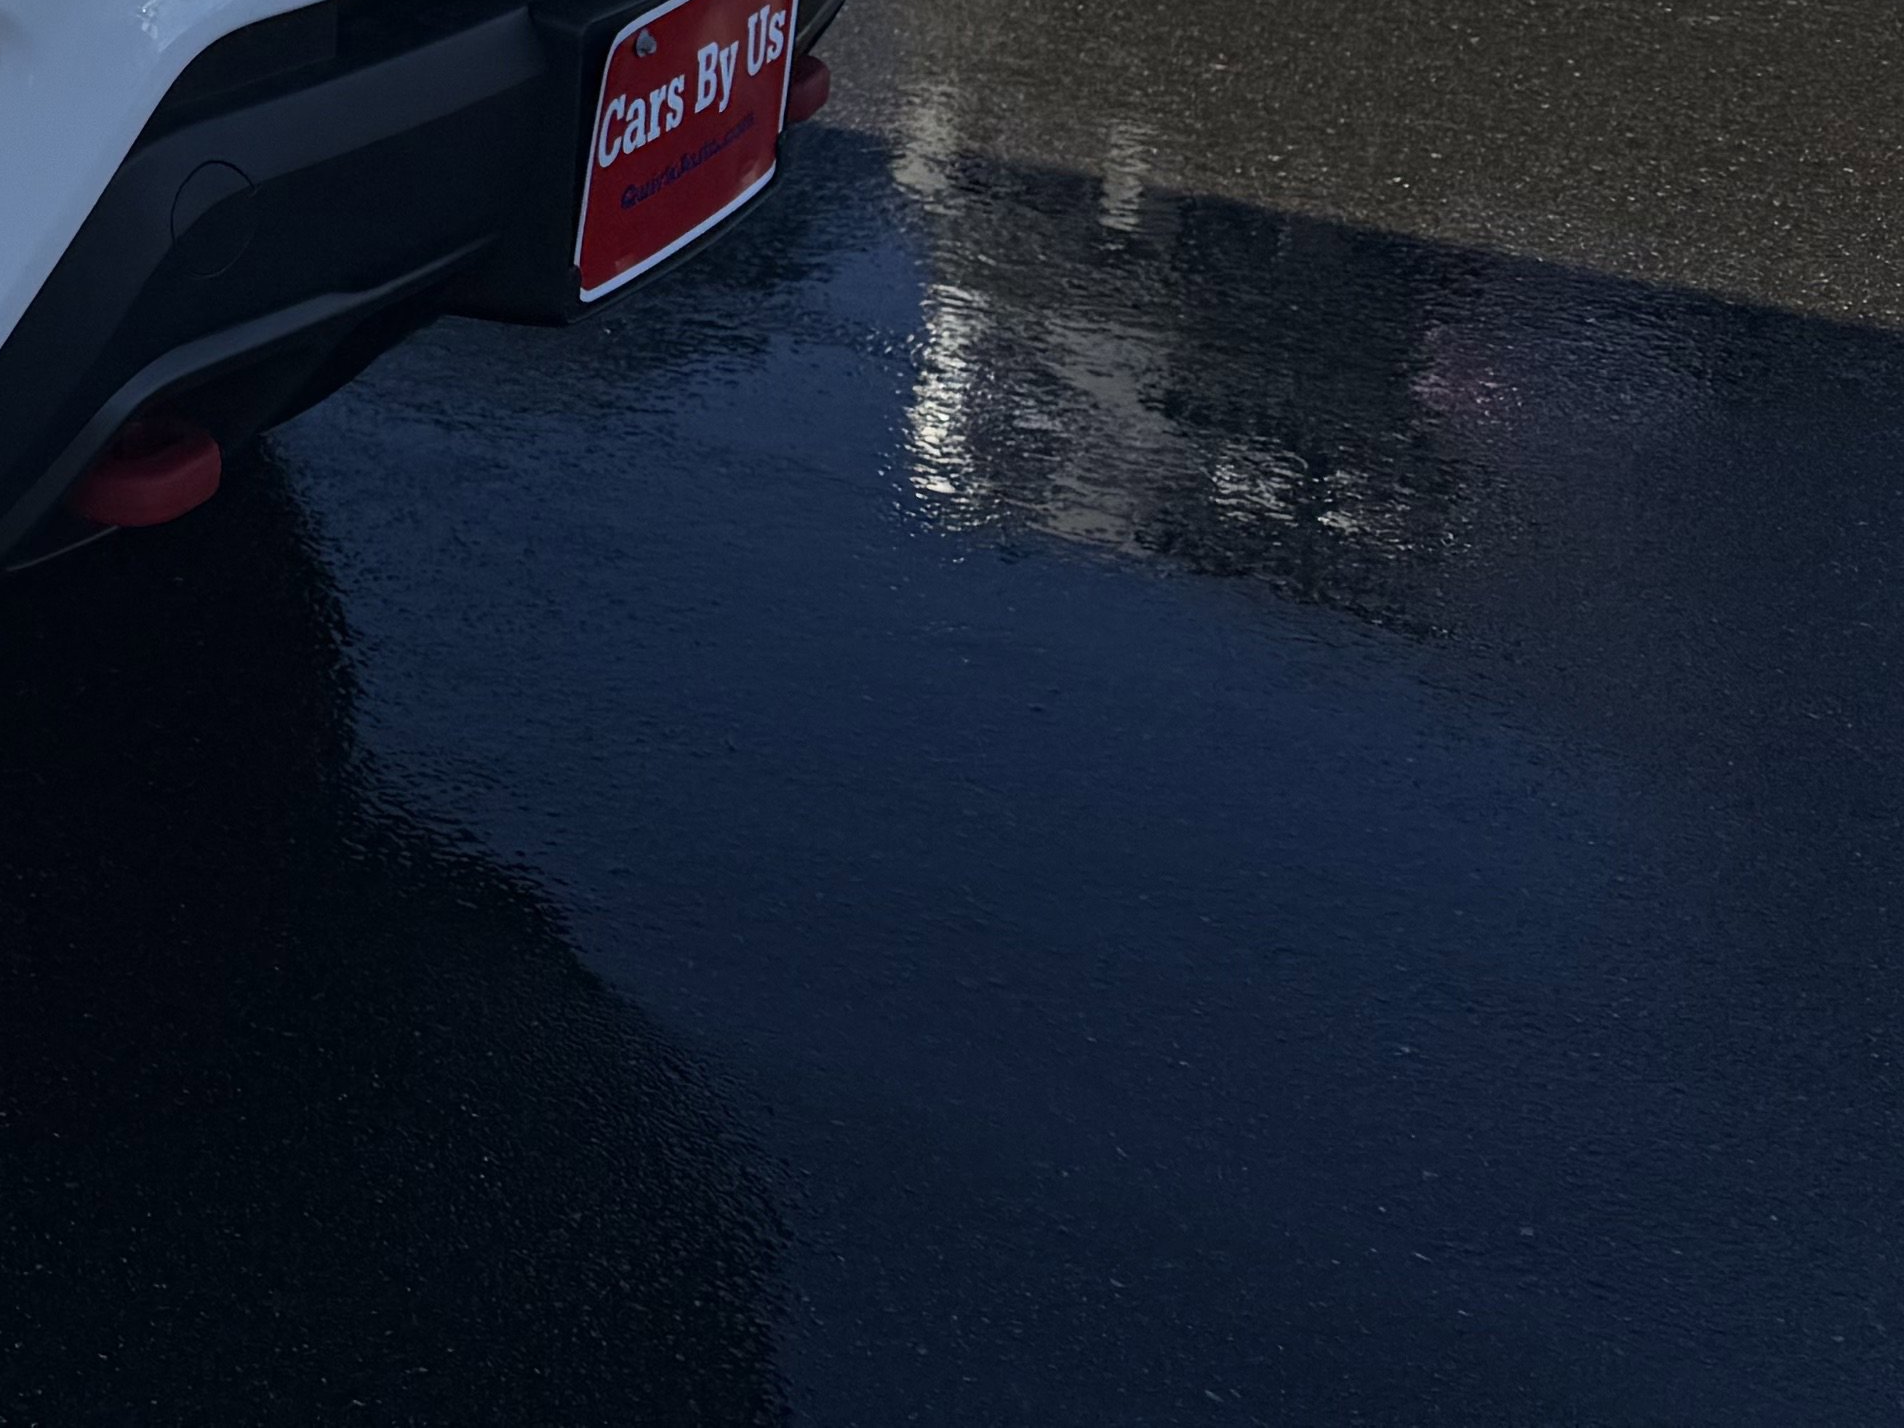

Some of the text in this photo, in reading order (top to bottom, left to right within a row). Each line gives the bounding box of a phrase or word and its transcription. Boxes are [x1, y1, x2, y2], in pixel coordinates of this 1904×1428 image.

[597, 3, 786, 168] Cars By Us
